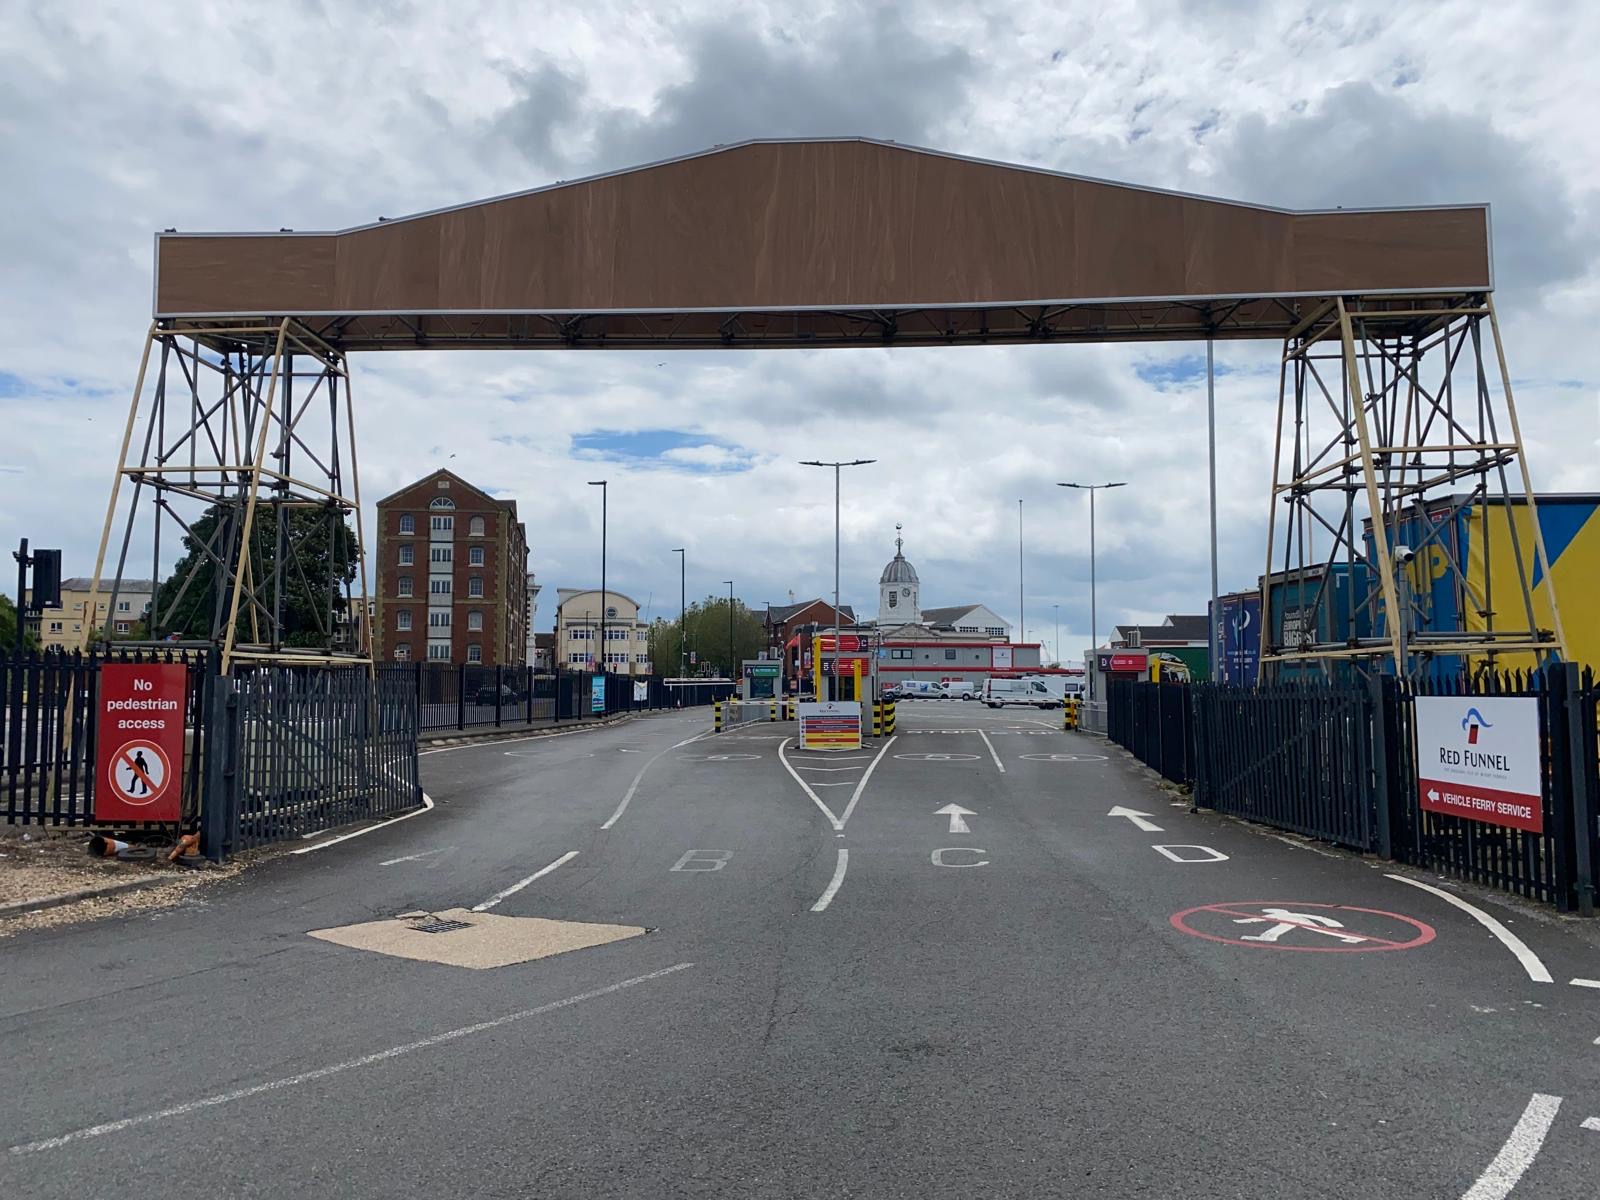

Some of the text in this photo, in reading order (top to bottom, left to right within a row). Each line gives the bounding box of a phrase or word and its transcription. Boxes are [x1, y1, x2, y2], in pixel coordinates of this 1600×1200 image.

[1283, 629, 1317, 647] BIGGST
[133, 679, 153, 691] No
[107, 698, 178, 712] pedestrian
[118, 719, 165, 729] access
[1440, 747, 1510, 771] RED FUNNEL
[1442, 793, 1532, 819] VEHICLE FERRY SERVICE
[669, 849, 735, 872] B
[931, 848, 990, 867] C
[1151, 844, 1230, 863] D
